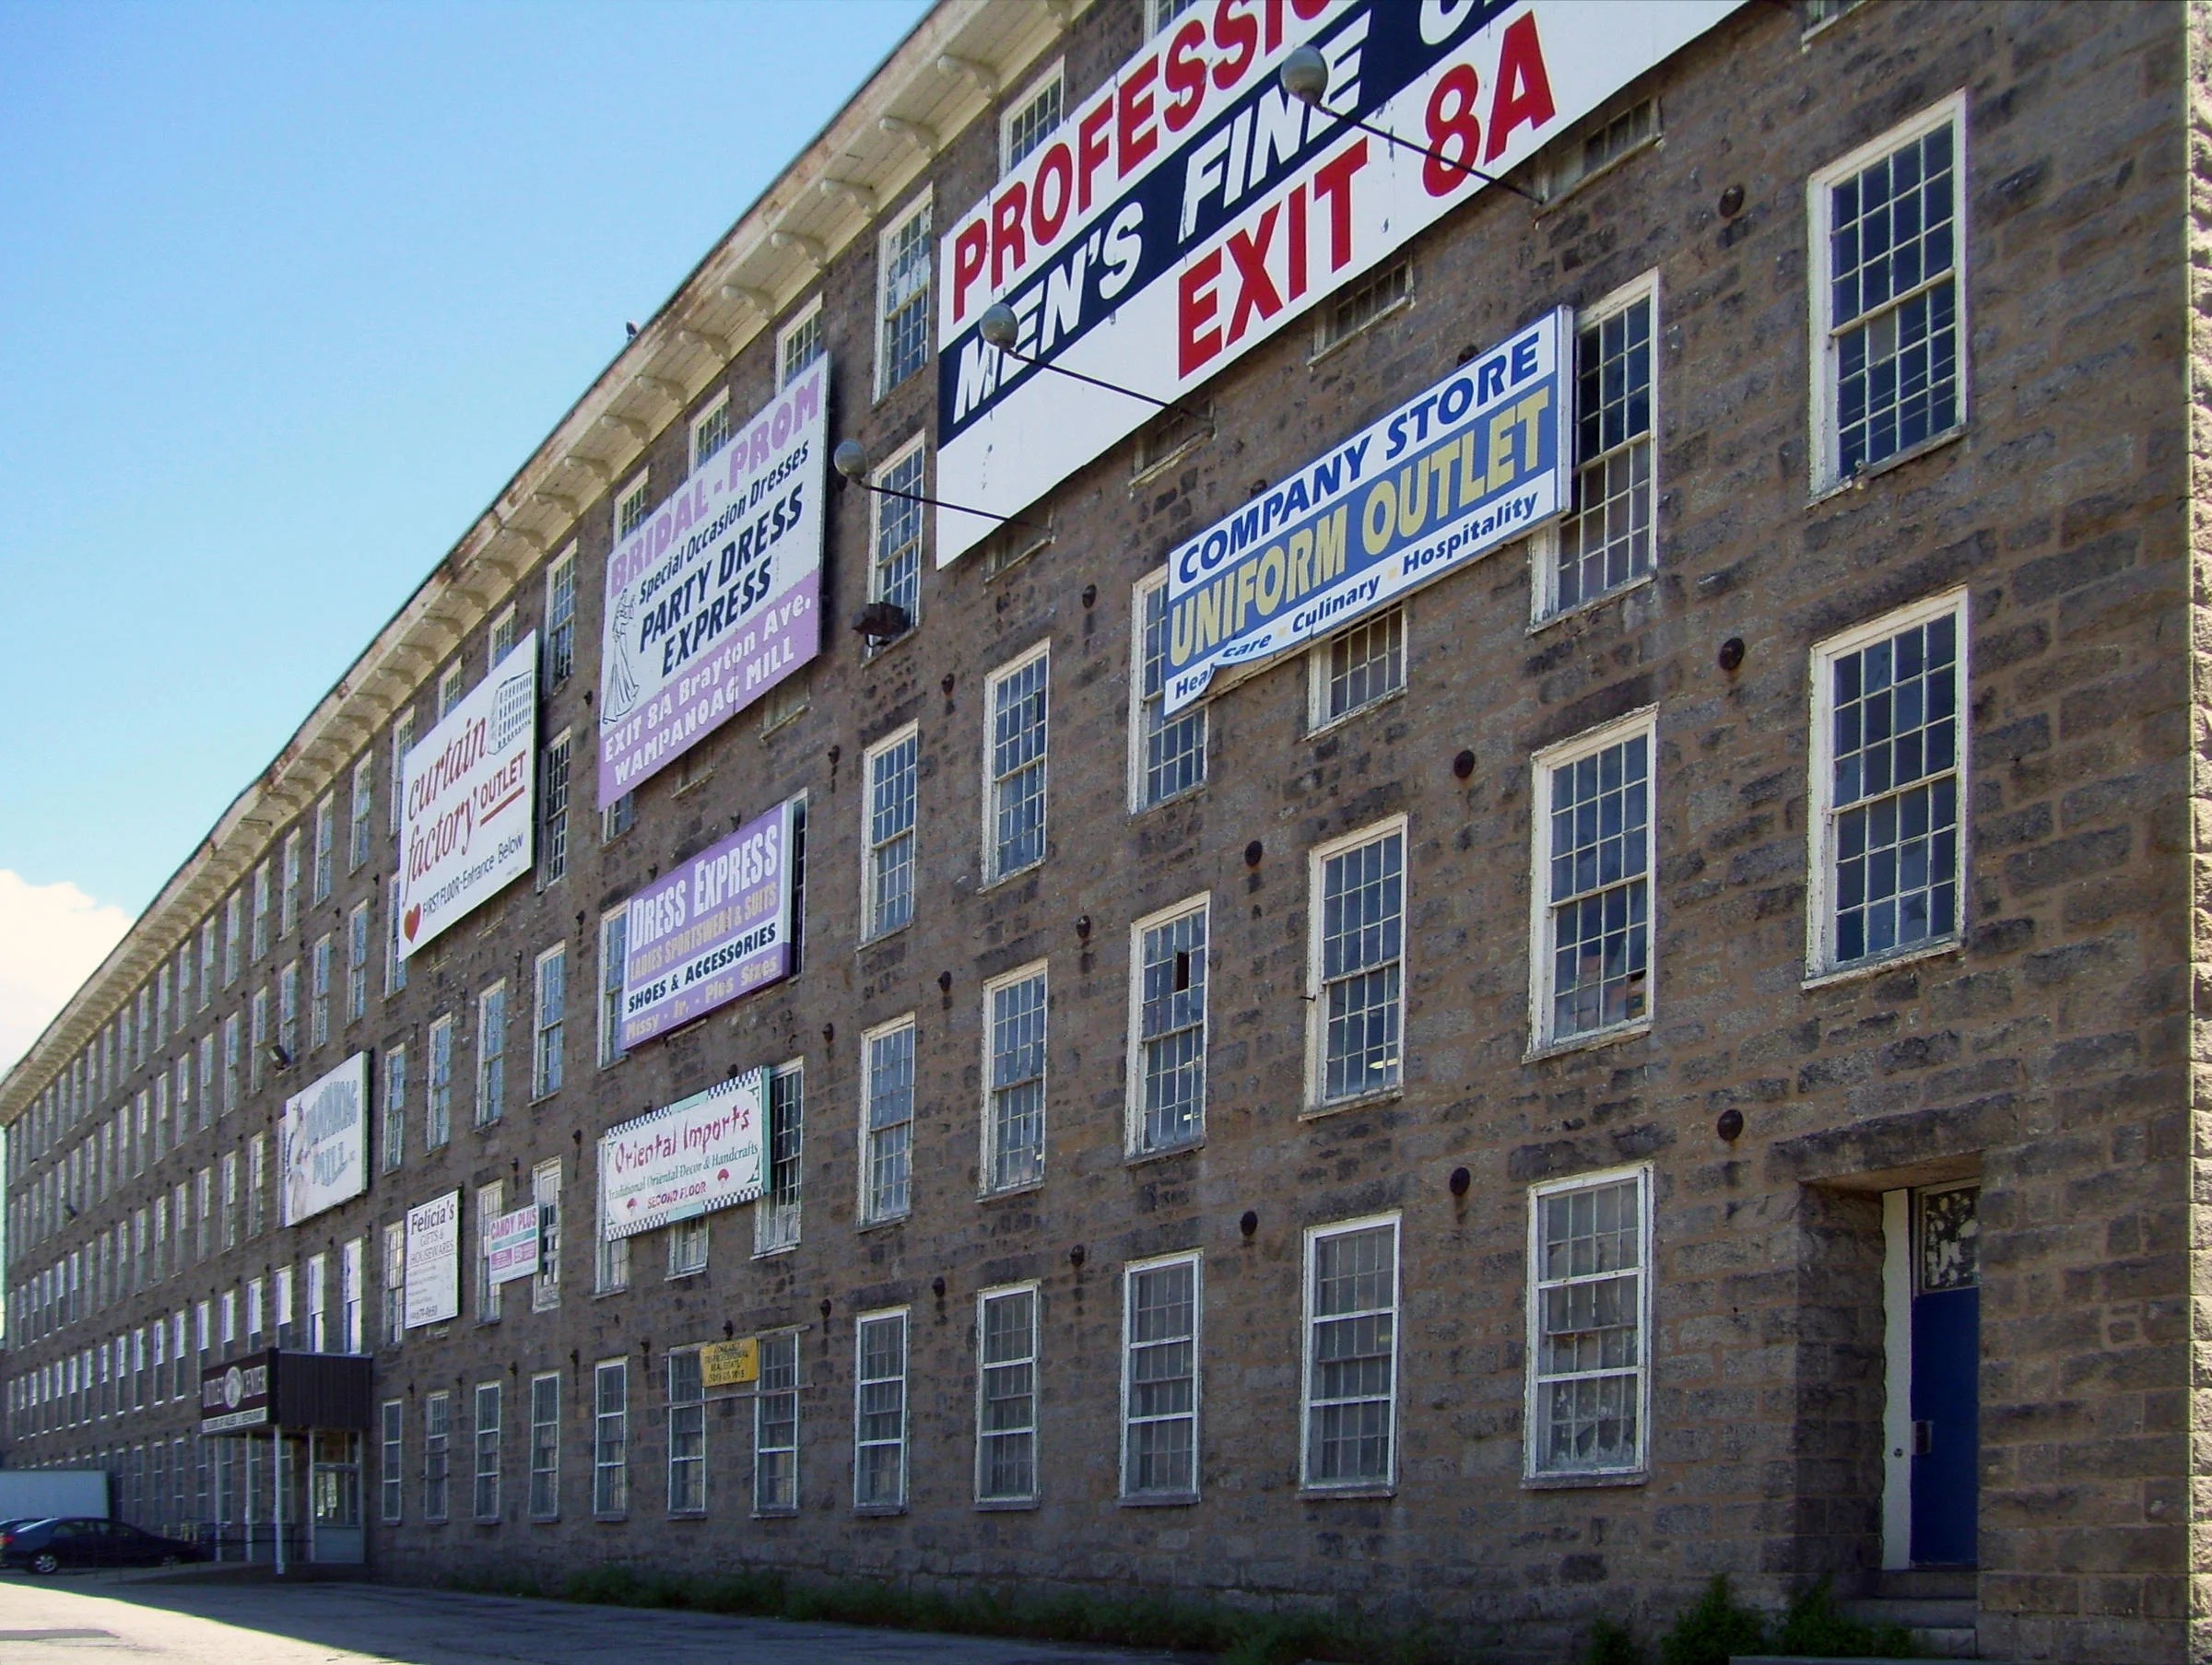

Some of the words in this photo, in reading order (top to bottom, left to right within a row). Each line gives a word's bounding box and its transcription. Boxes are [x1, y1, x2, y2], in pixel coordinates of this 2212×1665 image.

[953, 201, 1144, 425] MEN'S
[1178, 8, 1371, 244] FINE
[1178, 135, 1369, 381] EXIT
[1421, 9, 1556, 197] 8A
[611, 478, 708, 599] BRIDAL
[729, 370, 819, 492] PROM
[1179, 428, 1372, 584] COMPANY
[1386, 332, 1540, 459] STORE
[639, 545, 685, 604] Special
[687, 494, 747, 563] Occasion
[749, 439, 809, 509] Dresses
[639, 558, 712, 653] PARTY
[719, 481, 804, 587] DRESS
[1171, 504, 1347, 667] UNIFORM
[1361, 386, 1549, 555] OUTLET
[1222, 634, 1272, 658] care
[1292, 574, 1381, 633] Culinary
[1402, 489, 1538, 577] Hospitality
[605, 715, 642, 764] EXIT
[647, 693, 673, 730] 8A
[679, 631, 756, 706] Brayton
[763, 591, 812, 642] Ave.
[662, 555, 772, 678] EXPRESS
[407, 715, 487, 823] curtain
[615, 674, 738, 786] WAMPANOAG
[746, 635, 794, 691] MILL
[480, 749, 526, 810] OUTLET
[498, 832, 524, 864] Below
[631, 879, 687, 953] DRESS
[693, 825, 778, 918] EXPRESS
[745, 880, 777, 920] SUITS
[628, 979, 666, 1014] SHOES
[670, 973, 679, 991] &
[685, 922, 776, 985] ACCESSORIES
[705, 977, 735, 1003] Plus
[616, 1124, 677, 1175] Oriental
[683, 1105, 751, 1154] Imports
[647, 1190, 678, 1210] SECOND
[679, 1180, 708, 1199] FLOOR
[712, 1141, 759, 1167] Handcrafts
[411, 1200, 455, 1235] Felicia's
[517, 1207, 536, 1231] PLUS
